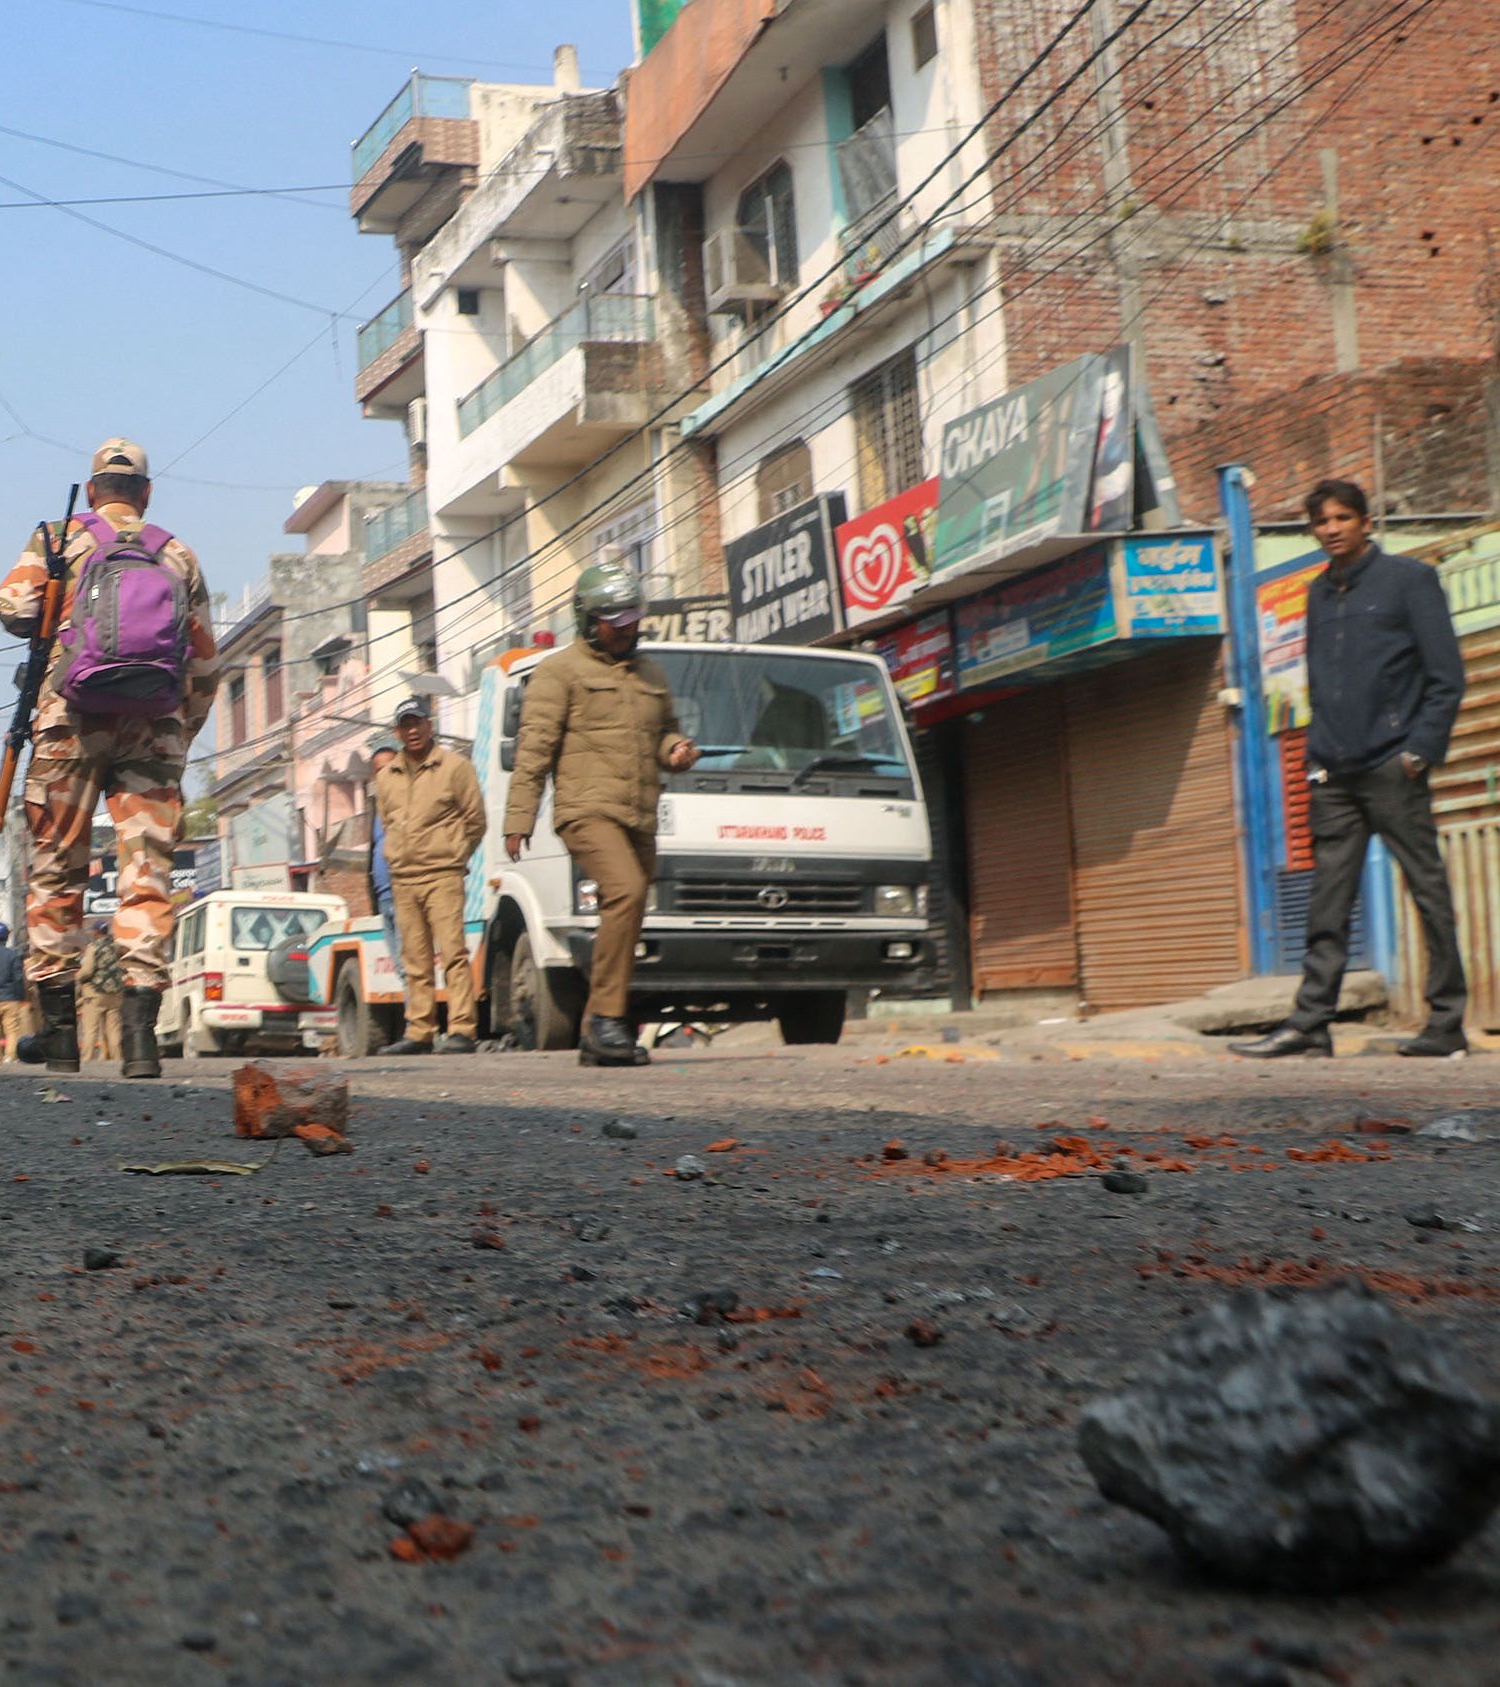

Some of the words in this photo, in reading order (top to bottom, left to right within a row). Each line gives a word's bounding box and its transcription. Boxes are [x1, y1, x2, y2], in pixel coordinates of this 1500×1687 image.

[943, 394, 1029, 480] OKAYA
[740, 528, 812, 605] STYLER
[783, 576, 831, 634] WEAR
[718, 825, 788, 840] UTTARAKHAND
[792, 826, 827, 841] POLICE
